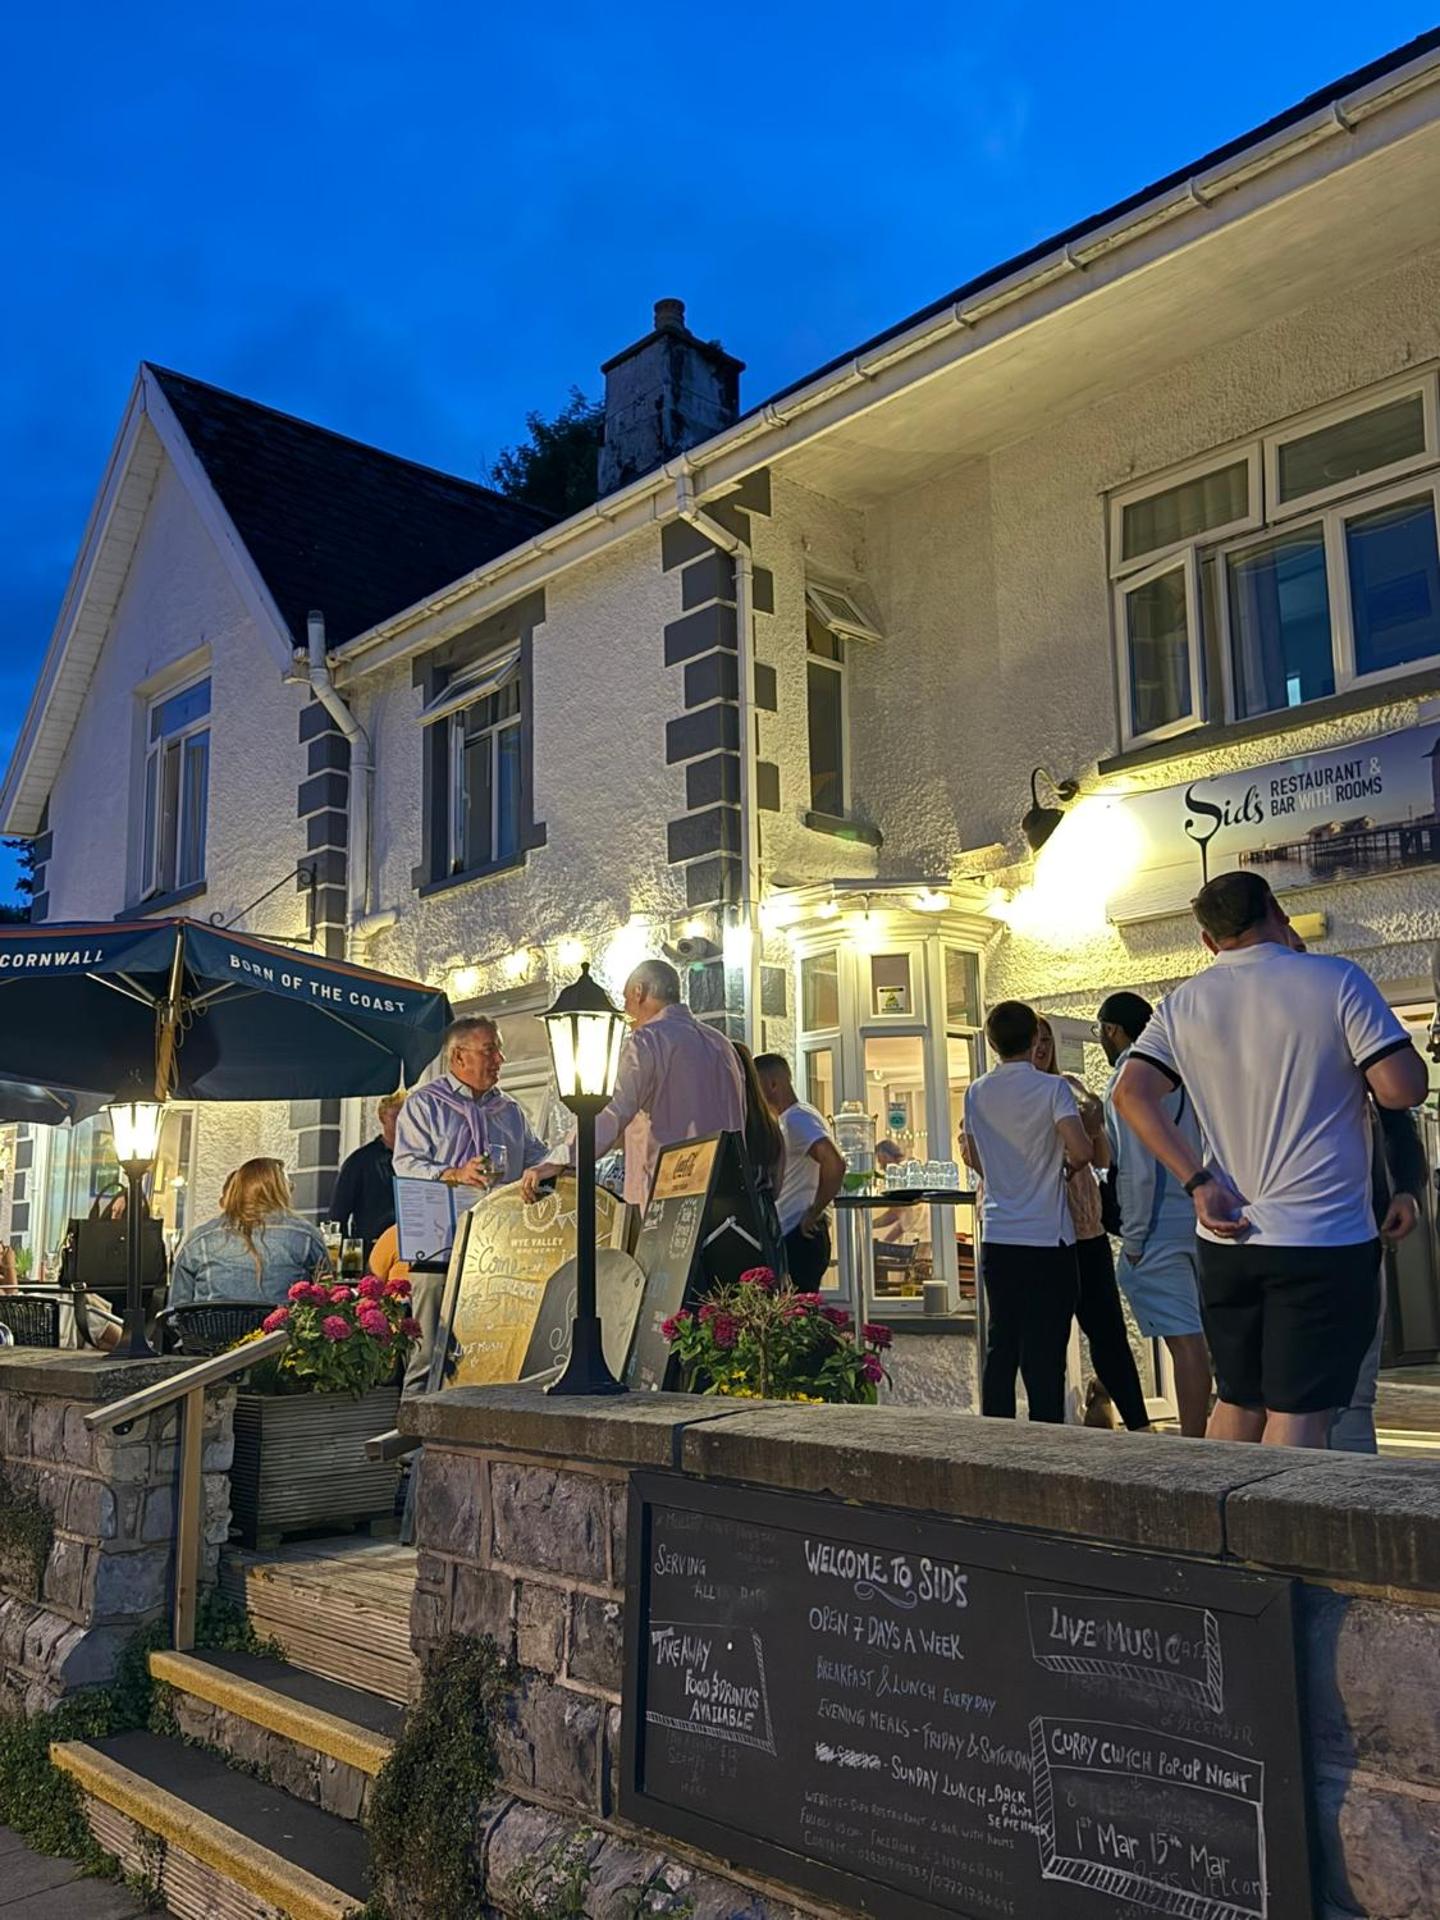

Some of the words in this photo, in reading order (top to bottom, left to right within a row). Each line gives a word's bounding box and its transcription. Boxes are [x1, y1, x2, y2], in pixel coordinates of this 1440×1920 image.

[1270, 760, 1362, 798] RESTAURANT
[1370, 756, 1381, 775] &
[1270, 796, 1295, 816] BAR
[1299, 787, 1332, 811] WITH
[1335, 777, 1383, 803] ROOMS
[1184, 782, 1264, 848] Sid's
[0, 949, 104, 968] CORNWALL
[229, 954, 274, 981] BORN
[281, 973, 303, 991] OF
[309, 981, 342, 1001] THE
[349, 991, 406, 1014] COAST
[531, 1237, 564, 1247] VALLEY
[653, 1543, 707, 1578] SERVING
[804, 1540, 889, 1585] WELCOME
[890, 1556, 914, 1589] TO
[918, 1557, 969, 1609] SID'S
[650, 1627, 713, 1673] TAKEAWAY
[808, 1605, 850, 1637] OPEN
[853, 1616, 865, 1642] 7
[866, 1616, 901, 1650] DAYS
[904, 1627, 917, 1654] A
[919, 1627, 965, 1661] WEEK
[1049, 1605, 1098, 1648] LIVE
[1104, 1619, 1182, 1665] MUSIC
[685, 1668, 710, 1699] FOOD
[719, 1679, 760, 1710] DRINKS
[816, 1656, 876, 1691] BREAKFAST
[875, 1664, 893, 1699] &
[892, 1674, 937, 1702] LUNCH
[689, 1699, 755, 1732] AVAILABLE
[818, 1698, 867, 1730] EVENING
[869, 1709, 911, 1739] MEALS
[921, 1721, 965, 1761] FRIDAY
[979, 1735, 1034, 1776] SATURDAY
[891, 1755, 939, 1795] SUNDAY
[1051, 1728, 1098, 1766] CURRY
[1205, 1761, 1253, 1795] NIGHT
[1097, 1823, 1140, 1860] Mar
[1189, 1843, 1231, 1879] Mar
